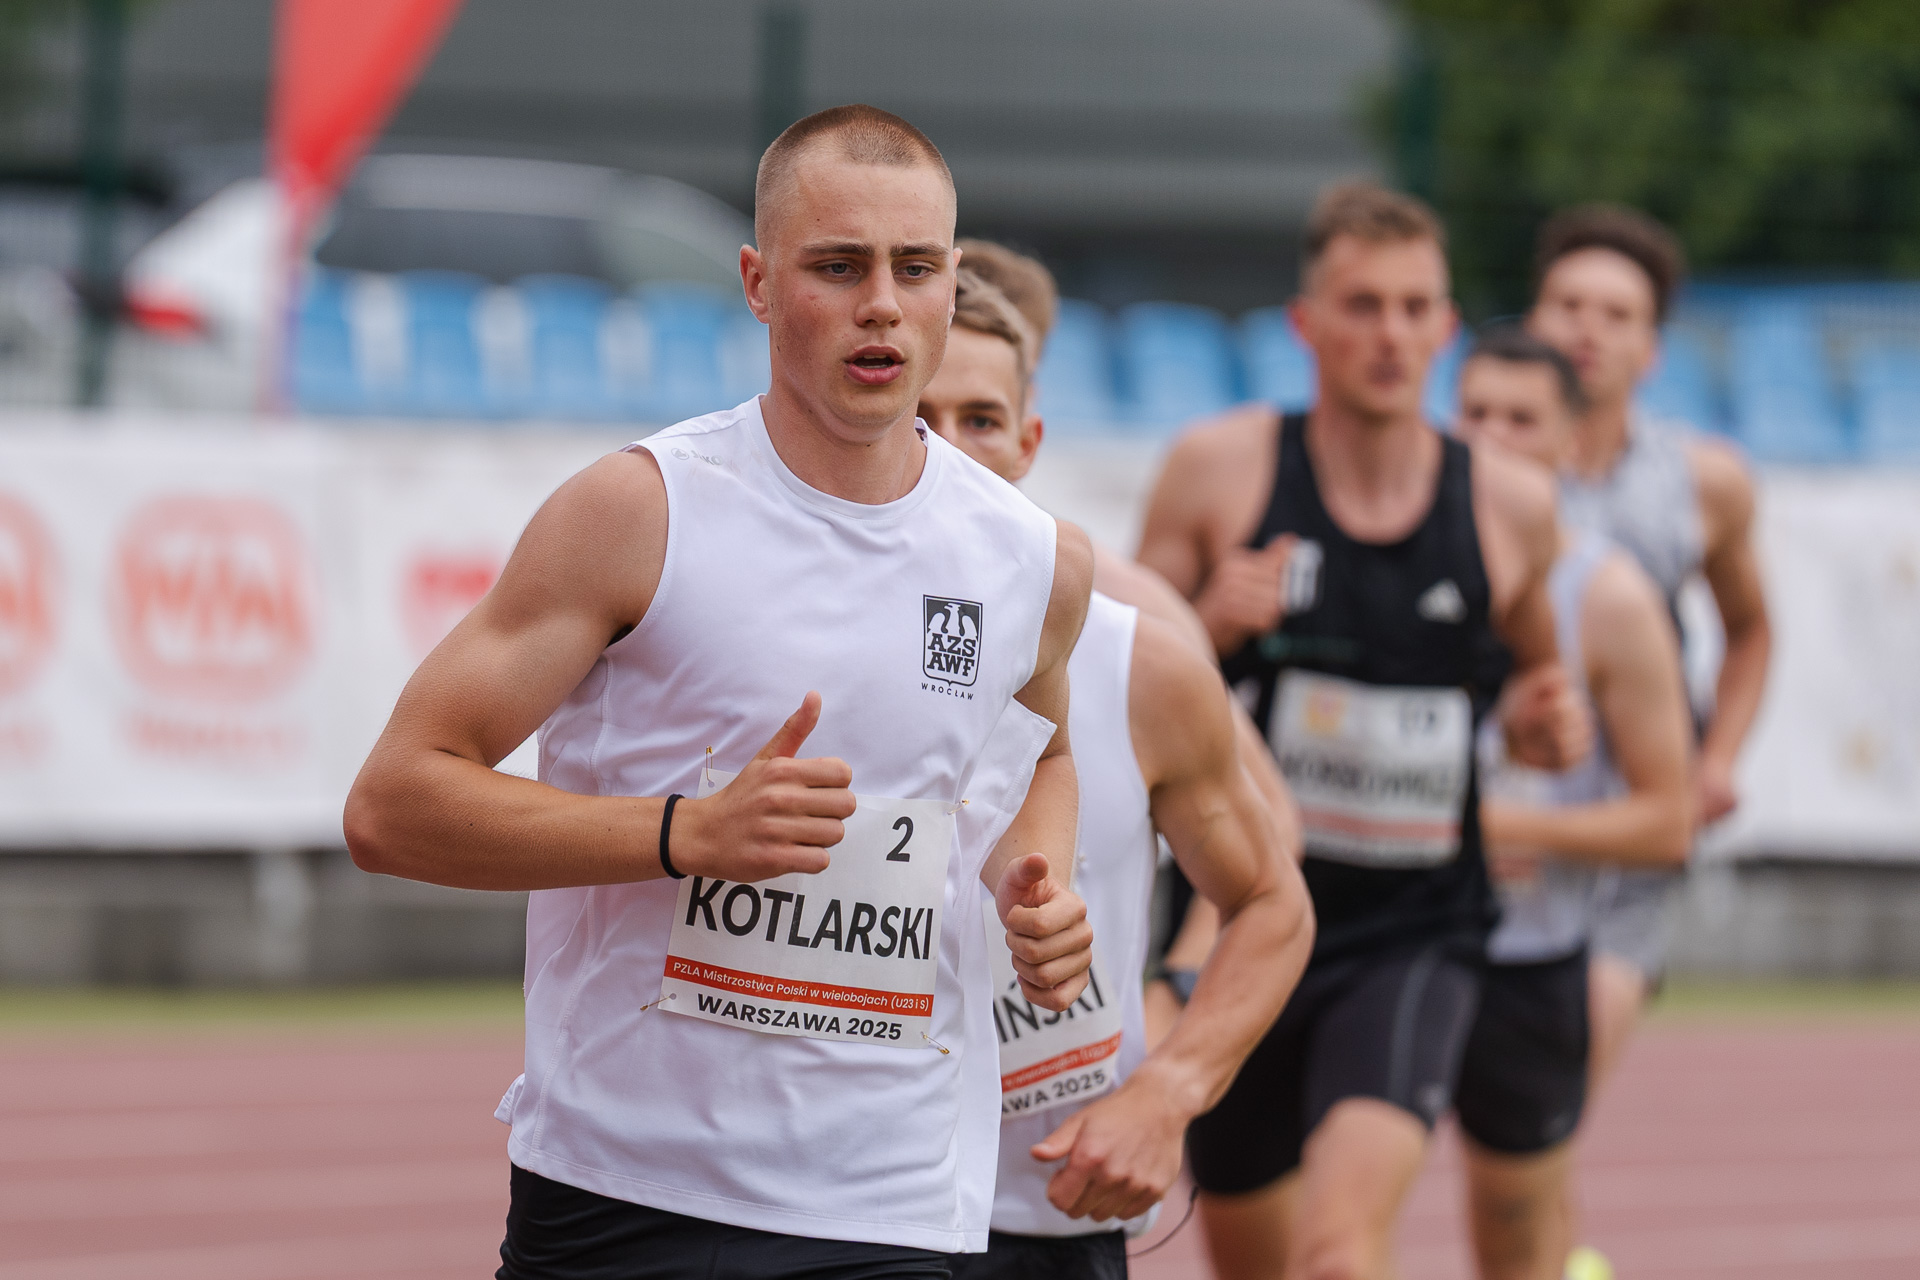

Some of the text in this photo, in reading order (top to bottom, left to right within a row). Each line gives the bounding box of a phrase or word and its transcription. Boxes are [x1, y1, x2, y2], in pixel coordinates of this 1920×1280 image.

[927, 651, 975, 676] AWF
[928, 633, 976, 657] AZS
[921, 682, 974, 700] WROCŁAW
[886, 816, 914, 862] 2
[685, 876, 934, 960] KOTLARSKI
[673, 962, 700, 977] PZLA
[703, 969, 774, 993] Mistrzostwa
[776, 983, 808, 998] Polski
[810, 989, 819, 998] w
[822, 988, 888, 1008] wielobojach
[891, 995, 914, 1011] (U23
[919, 997, 929, 1012] S)
[697, 993, 902, 1041] WARSZAWA 2025
[1052, 1070, 1106, 1098] 2025
